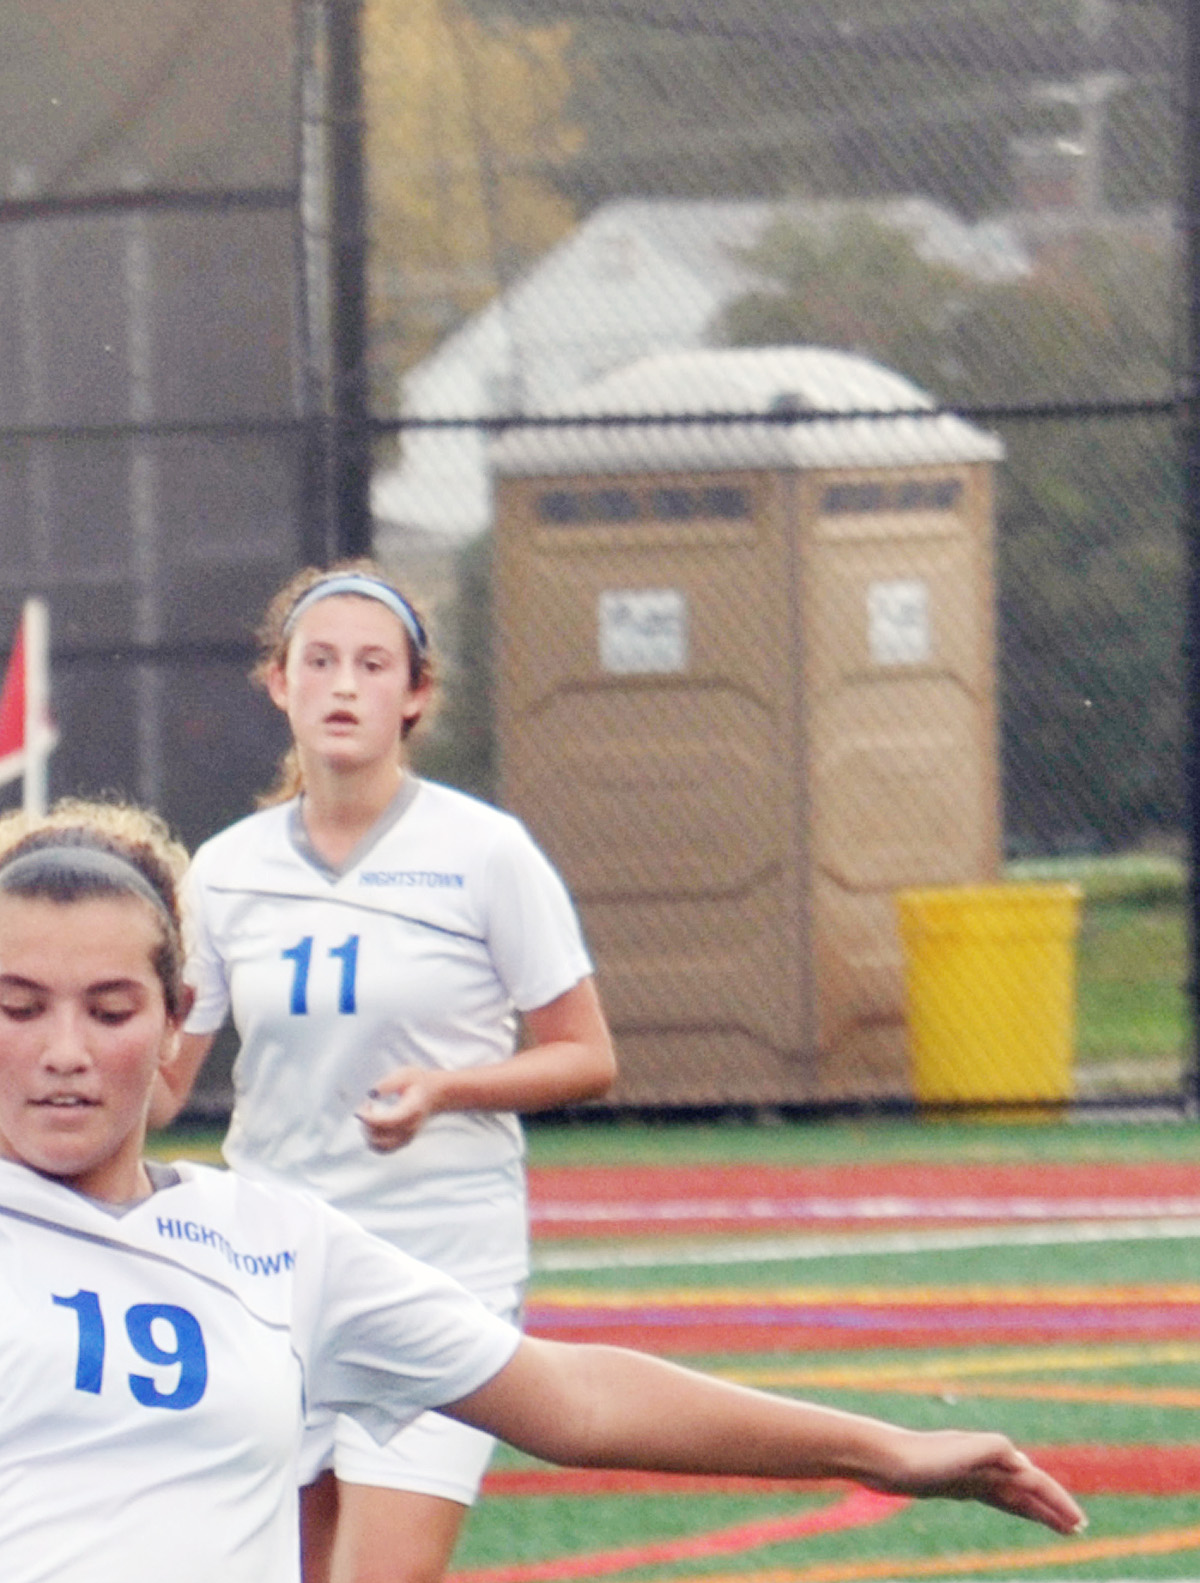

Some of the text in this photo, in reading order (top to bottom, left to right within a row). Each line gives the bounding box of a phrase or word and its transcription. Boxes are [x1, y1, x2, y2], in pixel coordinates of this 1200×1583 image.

[359, 870, 465, 889] HIGHTSTOWN
[281, 934, 360, 1016] 11
[156, 1215, 297, 1277] HIGHTTOWN
[50, 1288, 208, 1411] 19
